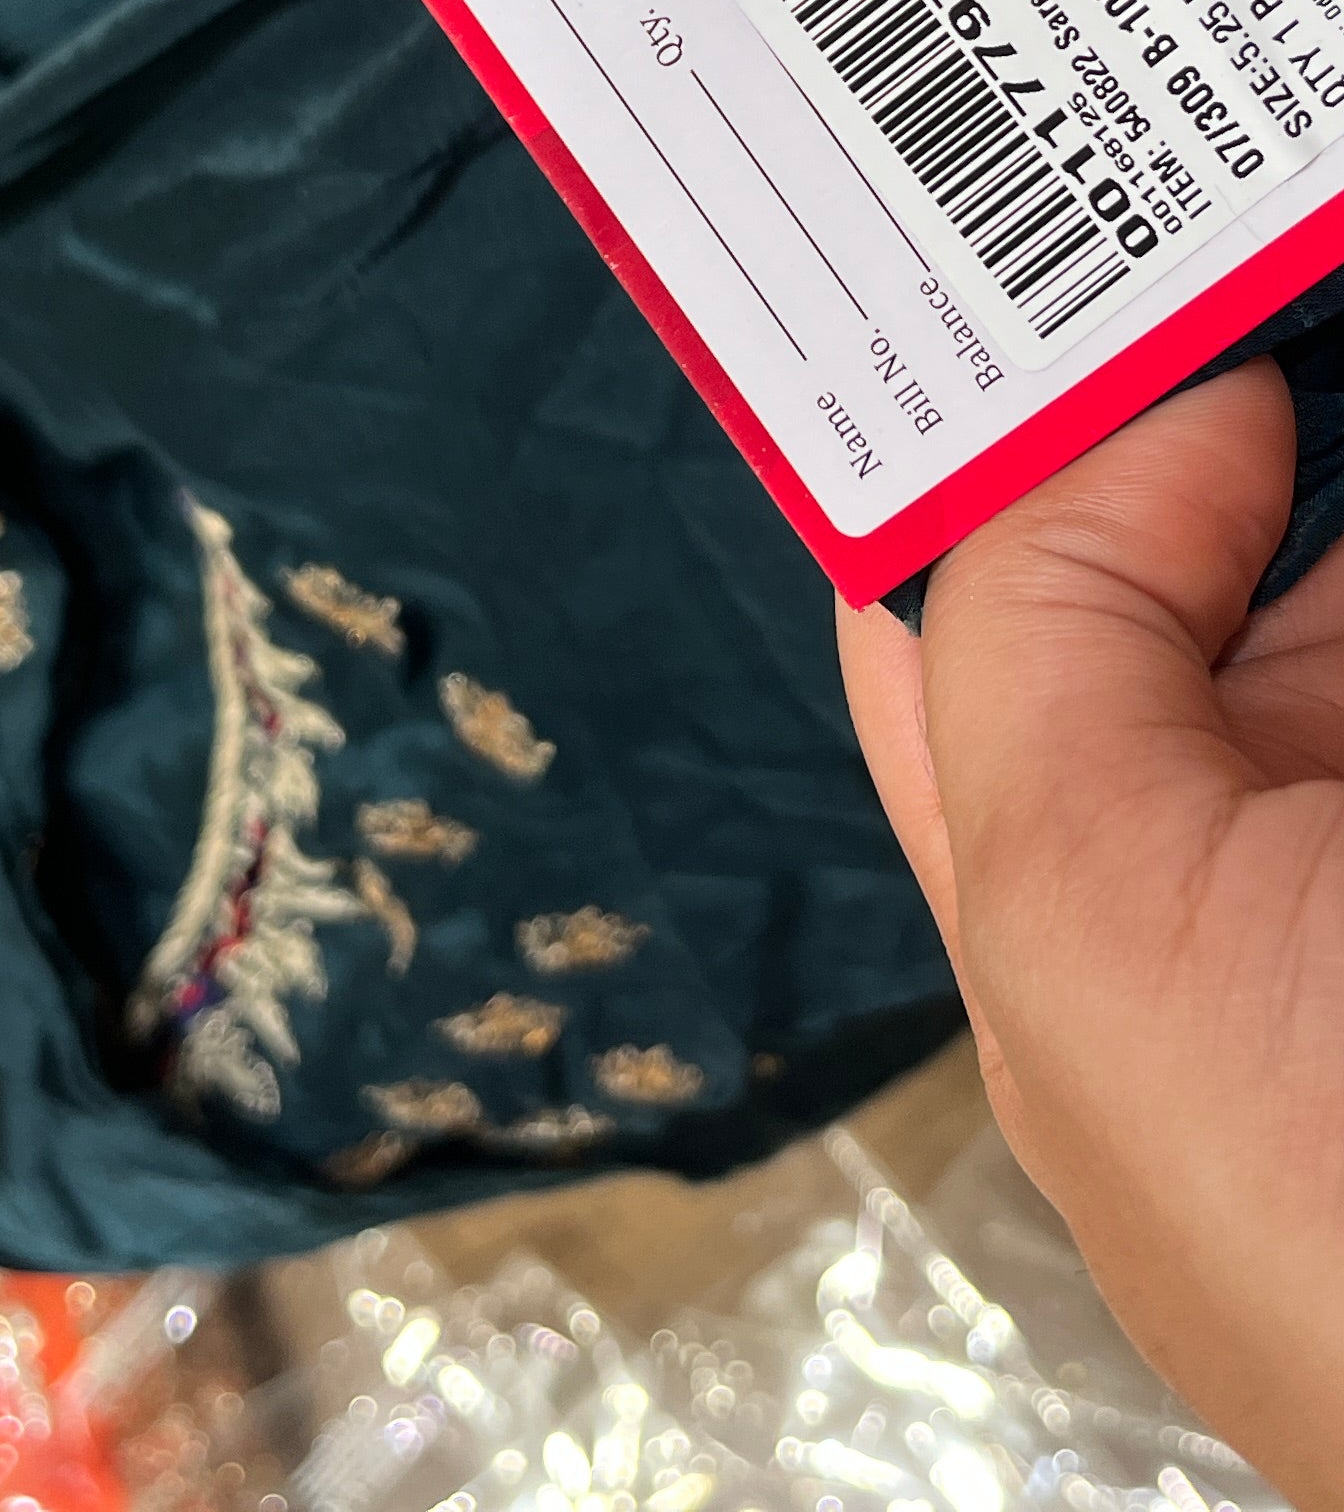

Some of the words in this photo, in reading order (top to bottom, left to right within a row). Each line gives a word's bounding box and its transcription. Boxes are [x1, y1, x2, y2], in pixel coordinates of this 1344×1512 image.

[638, 7, 683, 67] Qty.
[1270, 17, 1300, 45] 1
[1069, 44, 1152, 143] 540822
[1165, 64, 1265, 180] 07/309
[1065, 90, 1184, 236] 001168125
[1146, 138, 1213, 221] ITEM:
[869, 327, 907, 384] No.
[918, 276, 1005, 393] Balance
[815, 390, 883, 481] Name
[892, 377, 944, 436] Bill
